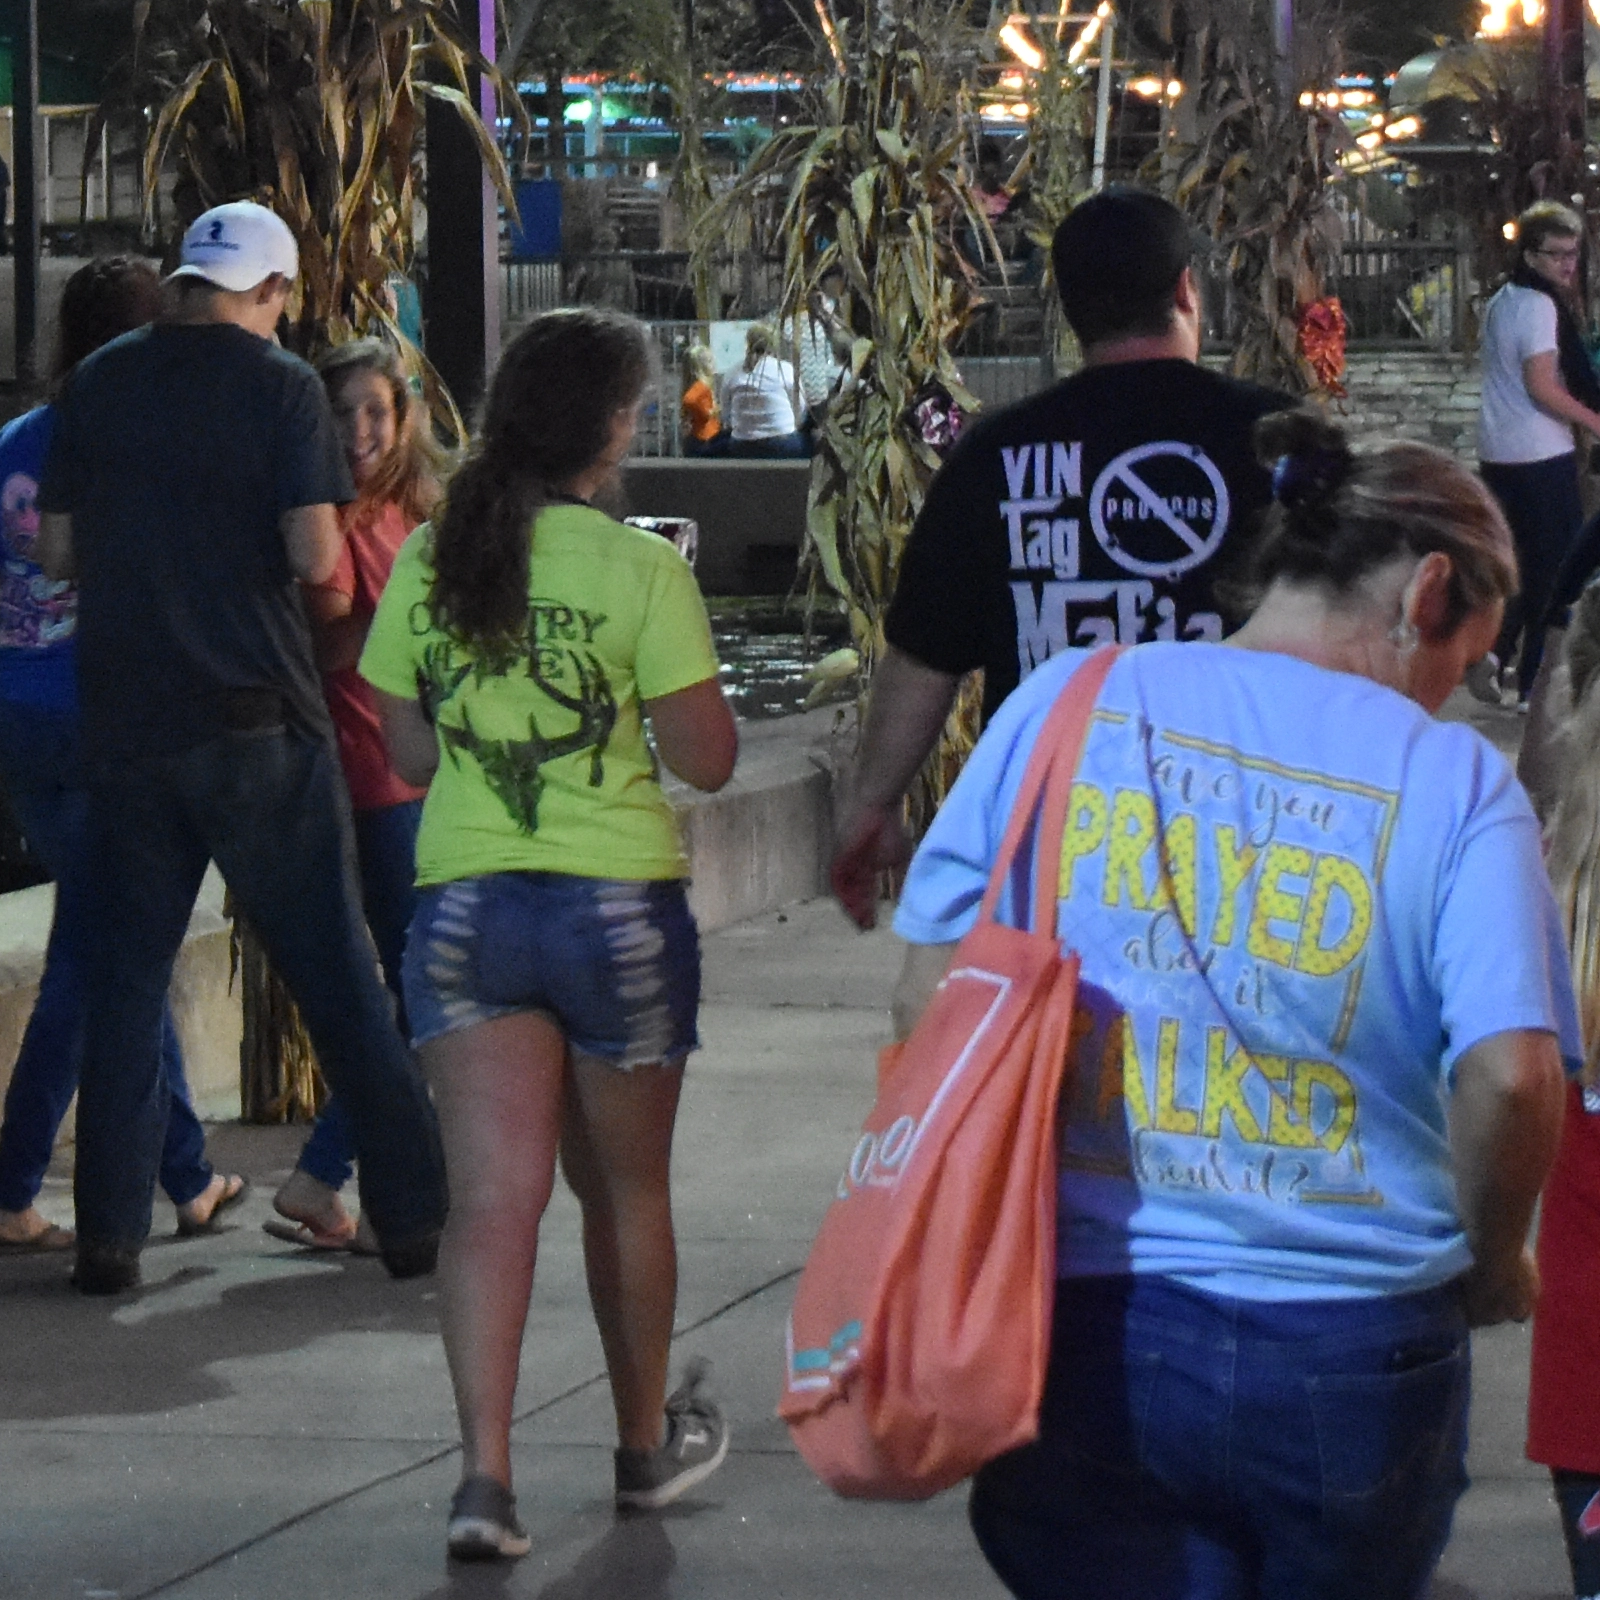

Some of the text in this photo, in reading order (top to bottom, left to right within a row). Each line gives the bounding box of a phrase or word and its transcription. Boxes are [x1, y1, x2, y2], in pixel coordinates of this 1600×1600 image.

[1001, 441, 1082, 499] VIN
[999, 500, 1081, 580] Tag
[1106, 496, 1213, 521] PROODS
[1138, 715, 1337, 849] ave you
[1057, 780, 1373, 977] PRAYED
[1123, 908, 1217, 975] abot
[1064, 1006, 1356, 1155] ALKED
[1131, 1124, 1234, 1196] bout
